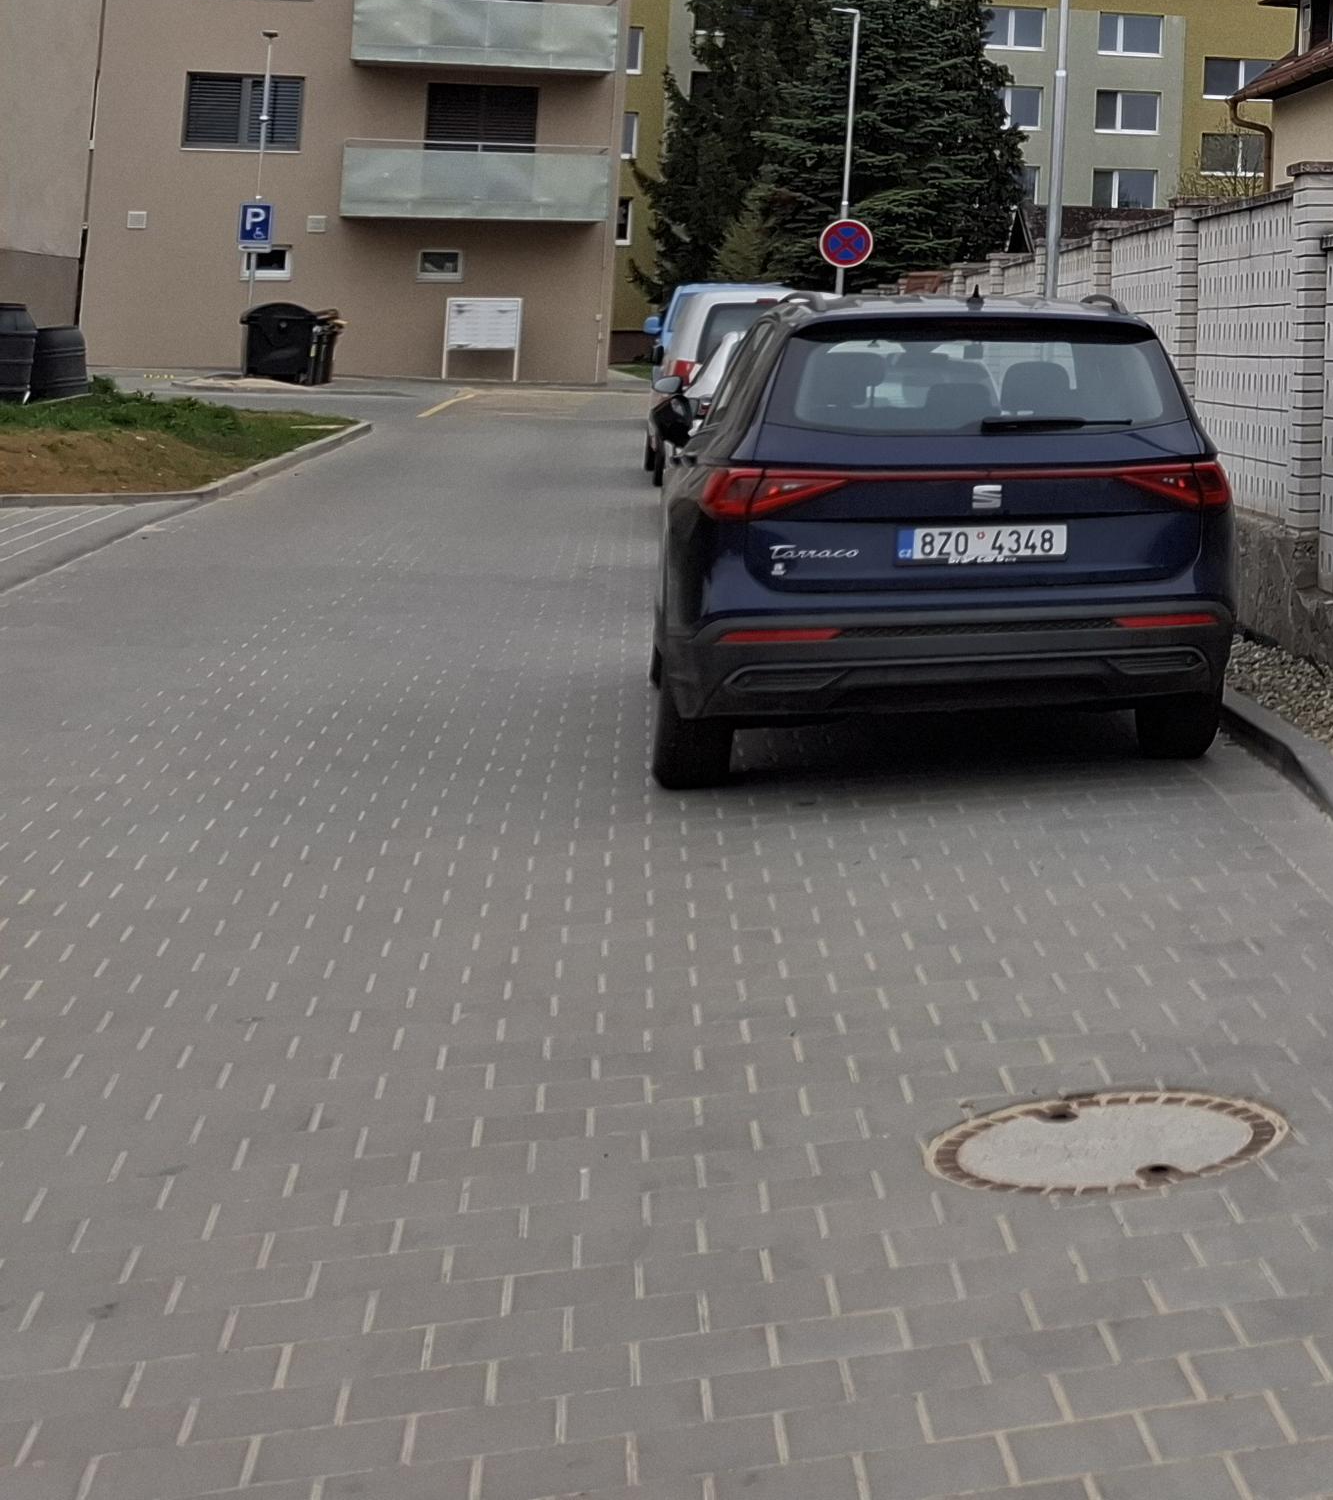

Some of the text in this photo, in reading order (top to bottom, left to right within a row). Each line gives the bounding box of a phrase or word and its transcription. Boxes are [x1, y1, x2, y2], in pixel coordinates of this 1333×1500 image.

[245, 208, 266, 231] P
[769, 544, 860, 560] Tarraco
[991, 529, 1055, 556] 4348
